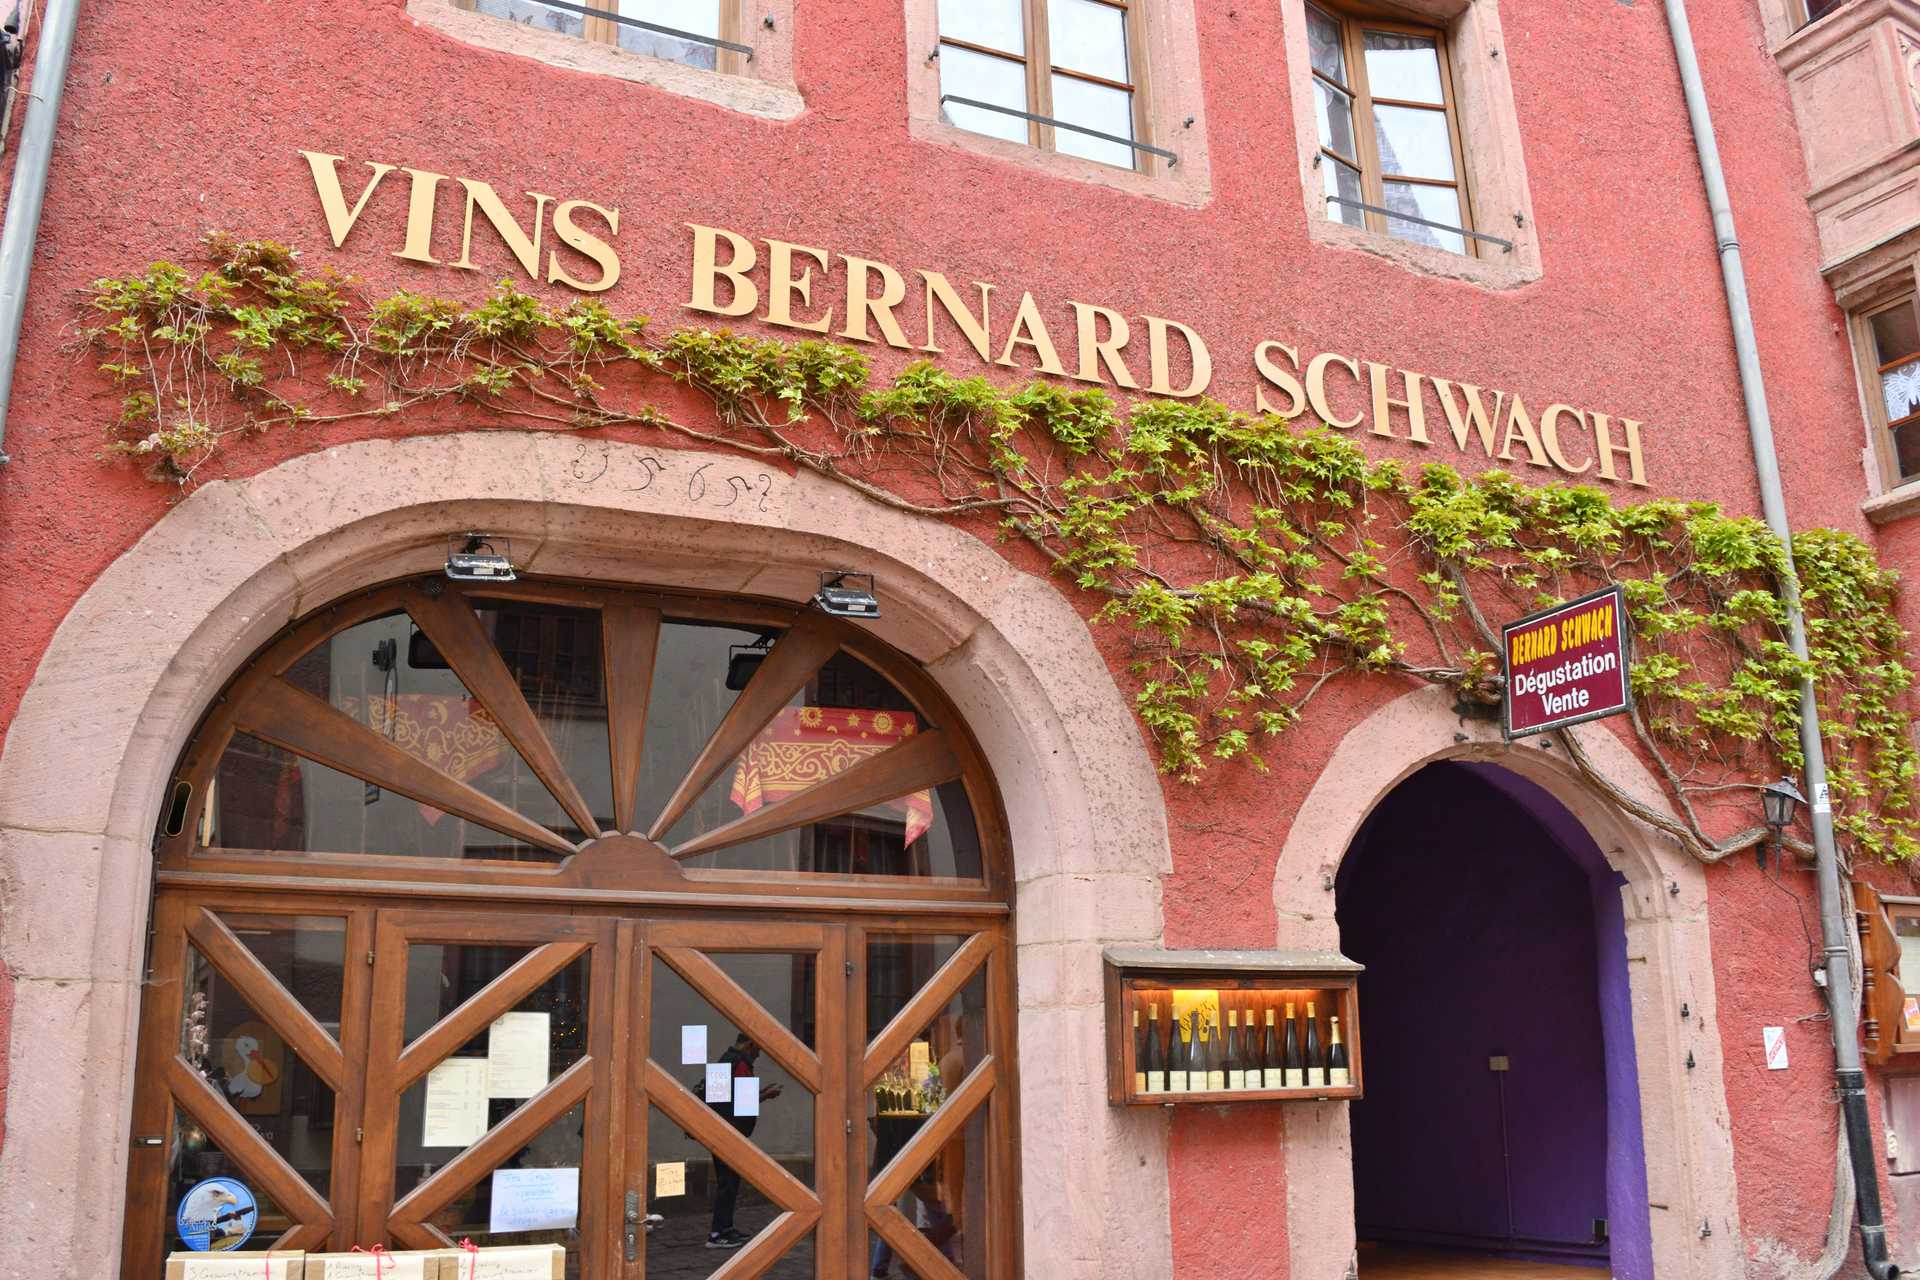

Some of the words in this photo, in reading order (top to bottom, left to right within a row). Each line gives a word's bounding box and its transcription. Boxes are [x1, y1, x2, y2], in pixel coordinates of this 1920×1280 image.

[298, 150, 621, 292] VINS
[682, 222, 1213, 398] BERNARD
[1253, 340, 1651, 487] SCHWACH
[1512, 625, 1558, 665] BERNARD
[1561, 605, 1613, 651] SCHWACH
[1514, 651, 1616, 697] Dégustation
[1541, 687, 1590, 716] Vente
